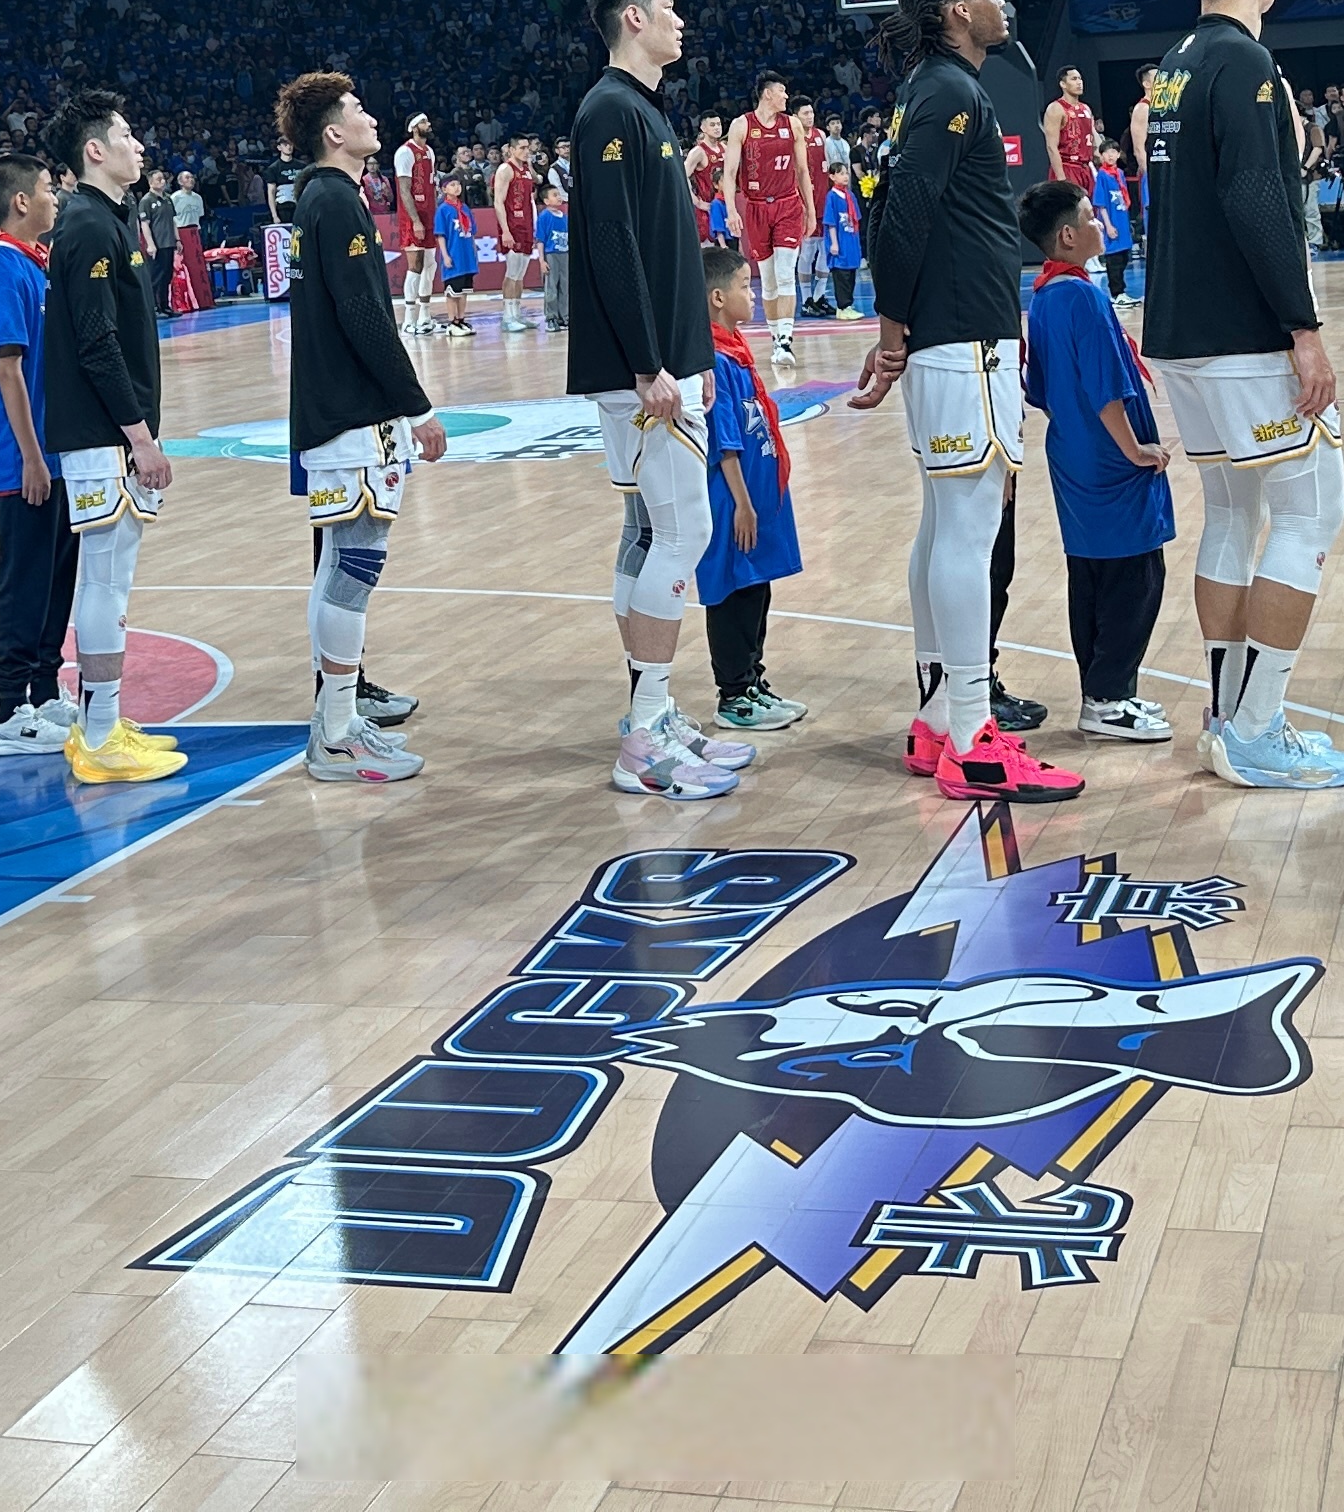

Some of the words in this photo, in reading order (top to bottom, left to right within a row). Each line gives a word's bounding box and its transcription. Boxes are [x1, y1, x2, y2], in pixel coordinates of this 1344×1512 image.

[774, 155, 791, 171] 17
[1253, 415, 1302, 443] 浙江
[929, 431, 974, 453] 浙江
[124, 847, 859, 1294] DUCKS
